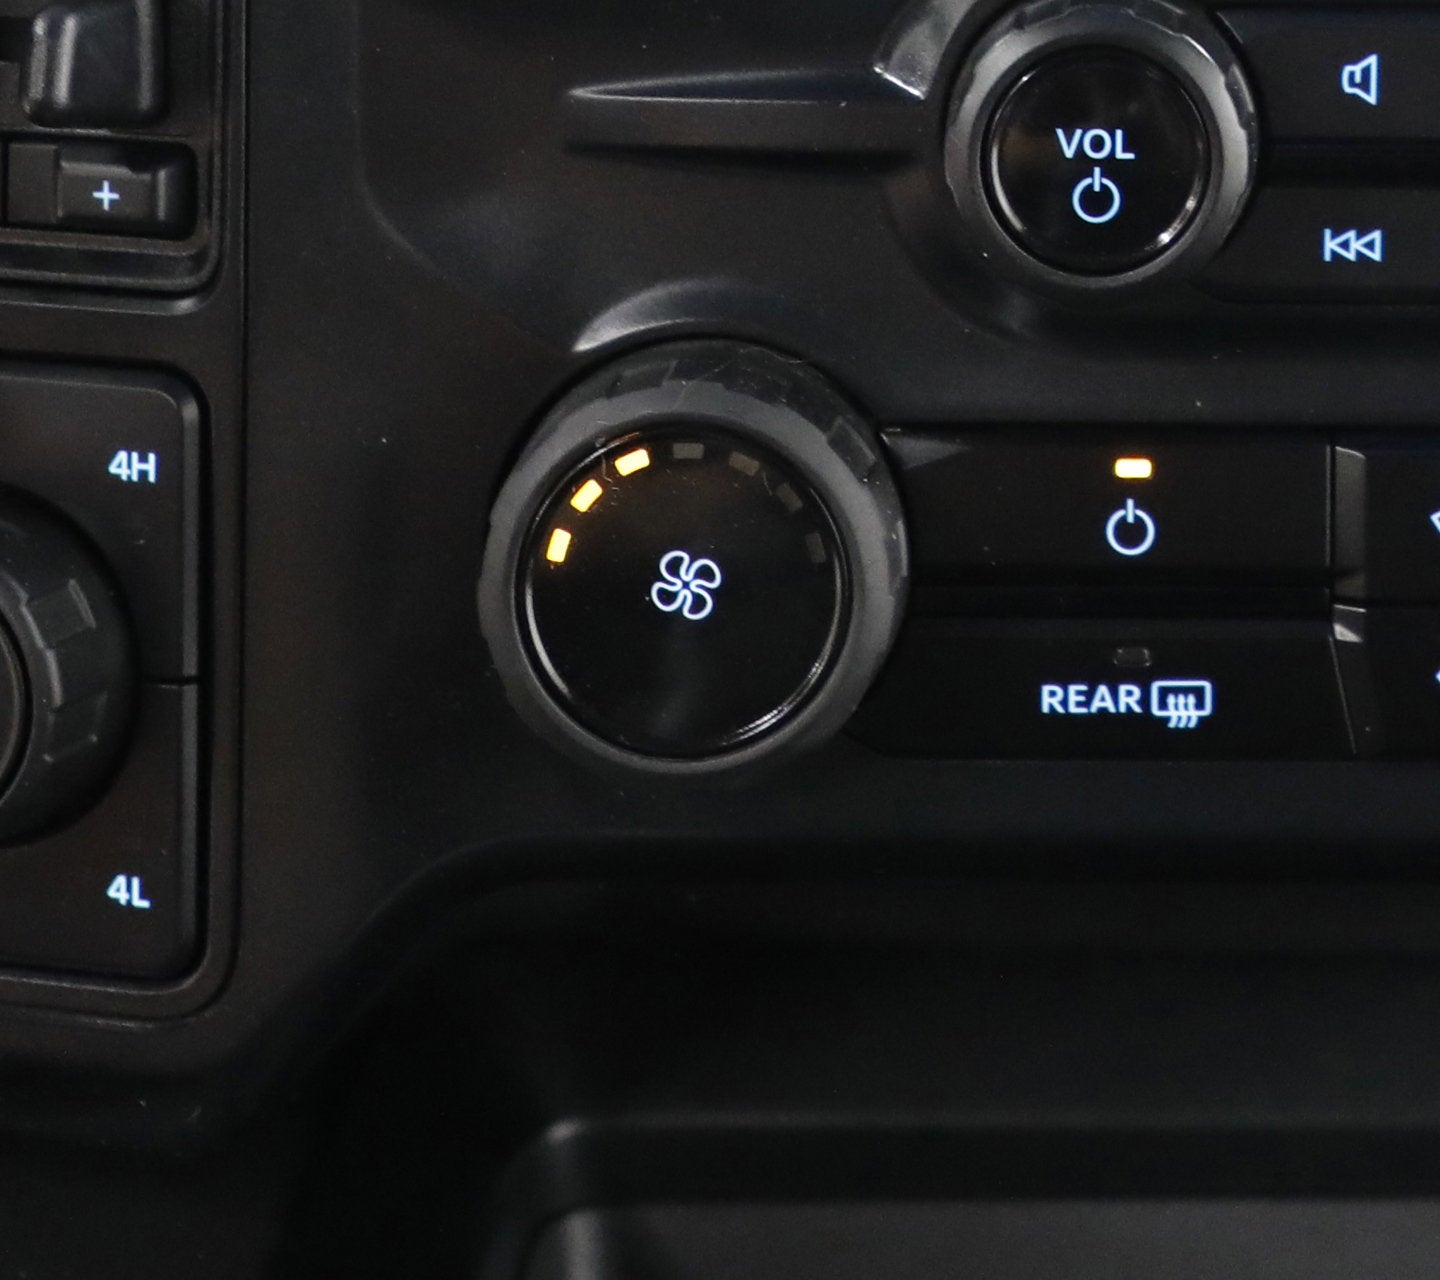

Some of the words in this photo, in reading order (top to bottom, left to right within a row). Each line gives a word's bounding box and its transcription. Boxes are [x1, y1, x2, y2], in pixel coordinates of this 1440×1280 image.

[1056, 129, 1136, 160] VOL
[108, 451, 156, 482] 4H
[1041, 684, 1142, 715] REAR
[107, 877, 150, 908] 4L
